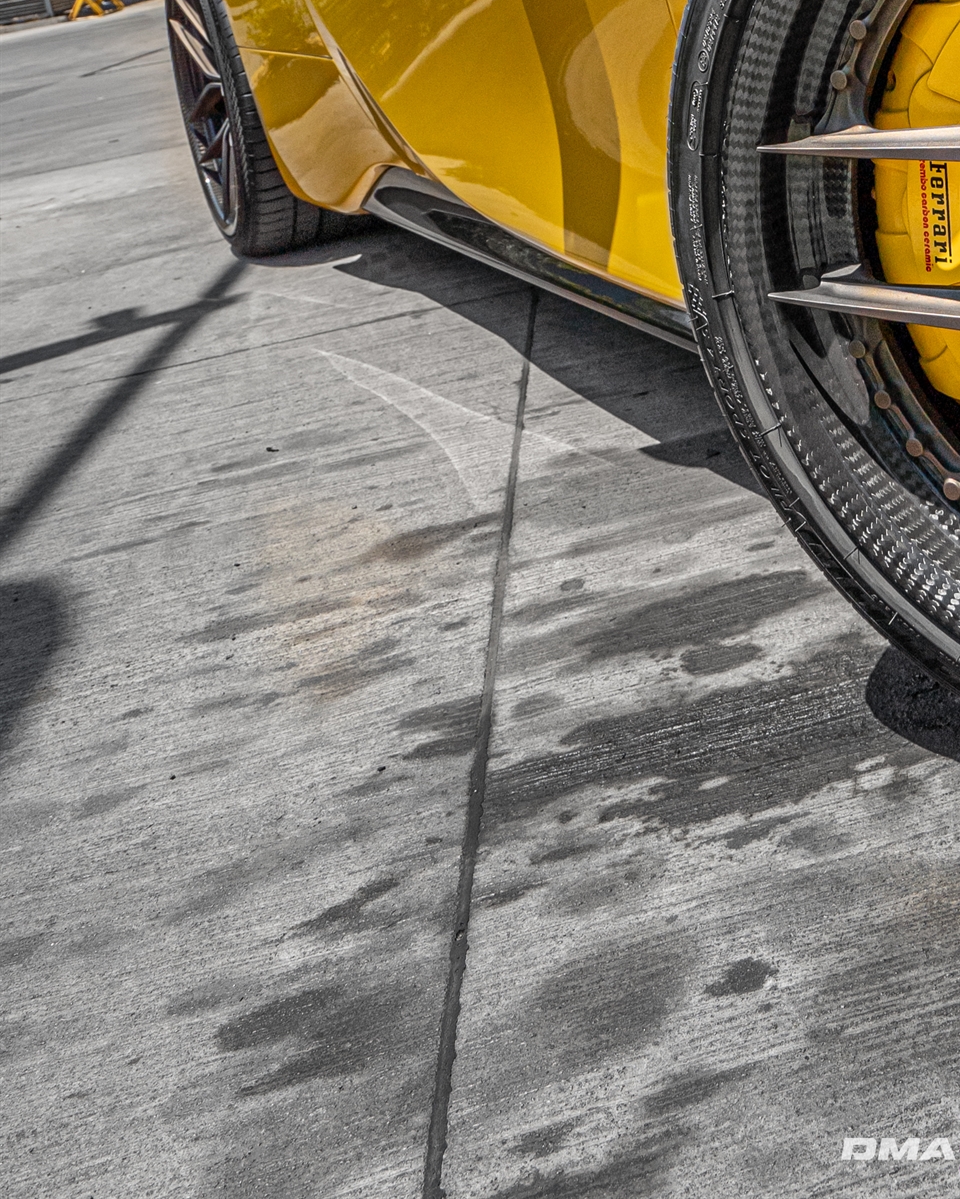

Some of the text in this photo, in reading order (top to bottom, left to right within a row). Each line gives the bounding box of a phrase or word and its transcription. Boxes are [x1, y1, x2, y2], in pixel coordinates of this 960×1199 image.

[919, 160, 934, 272] rembo carbon ceramic
[930, 161, 952, 264] Ferrari
